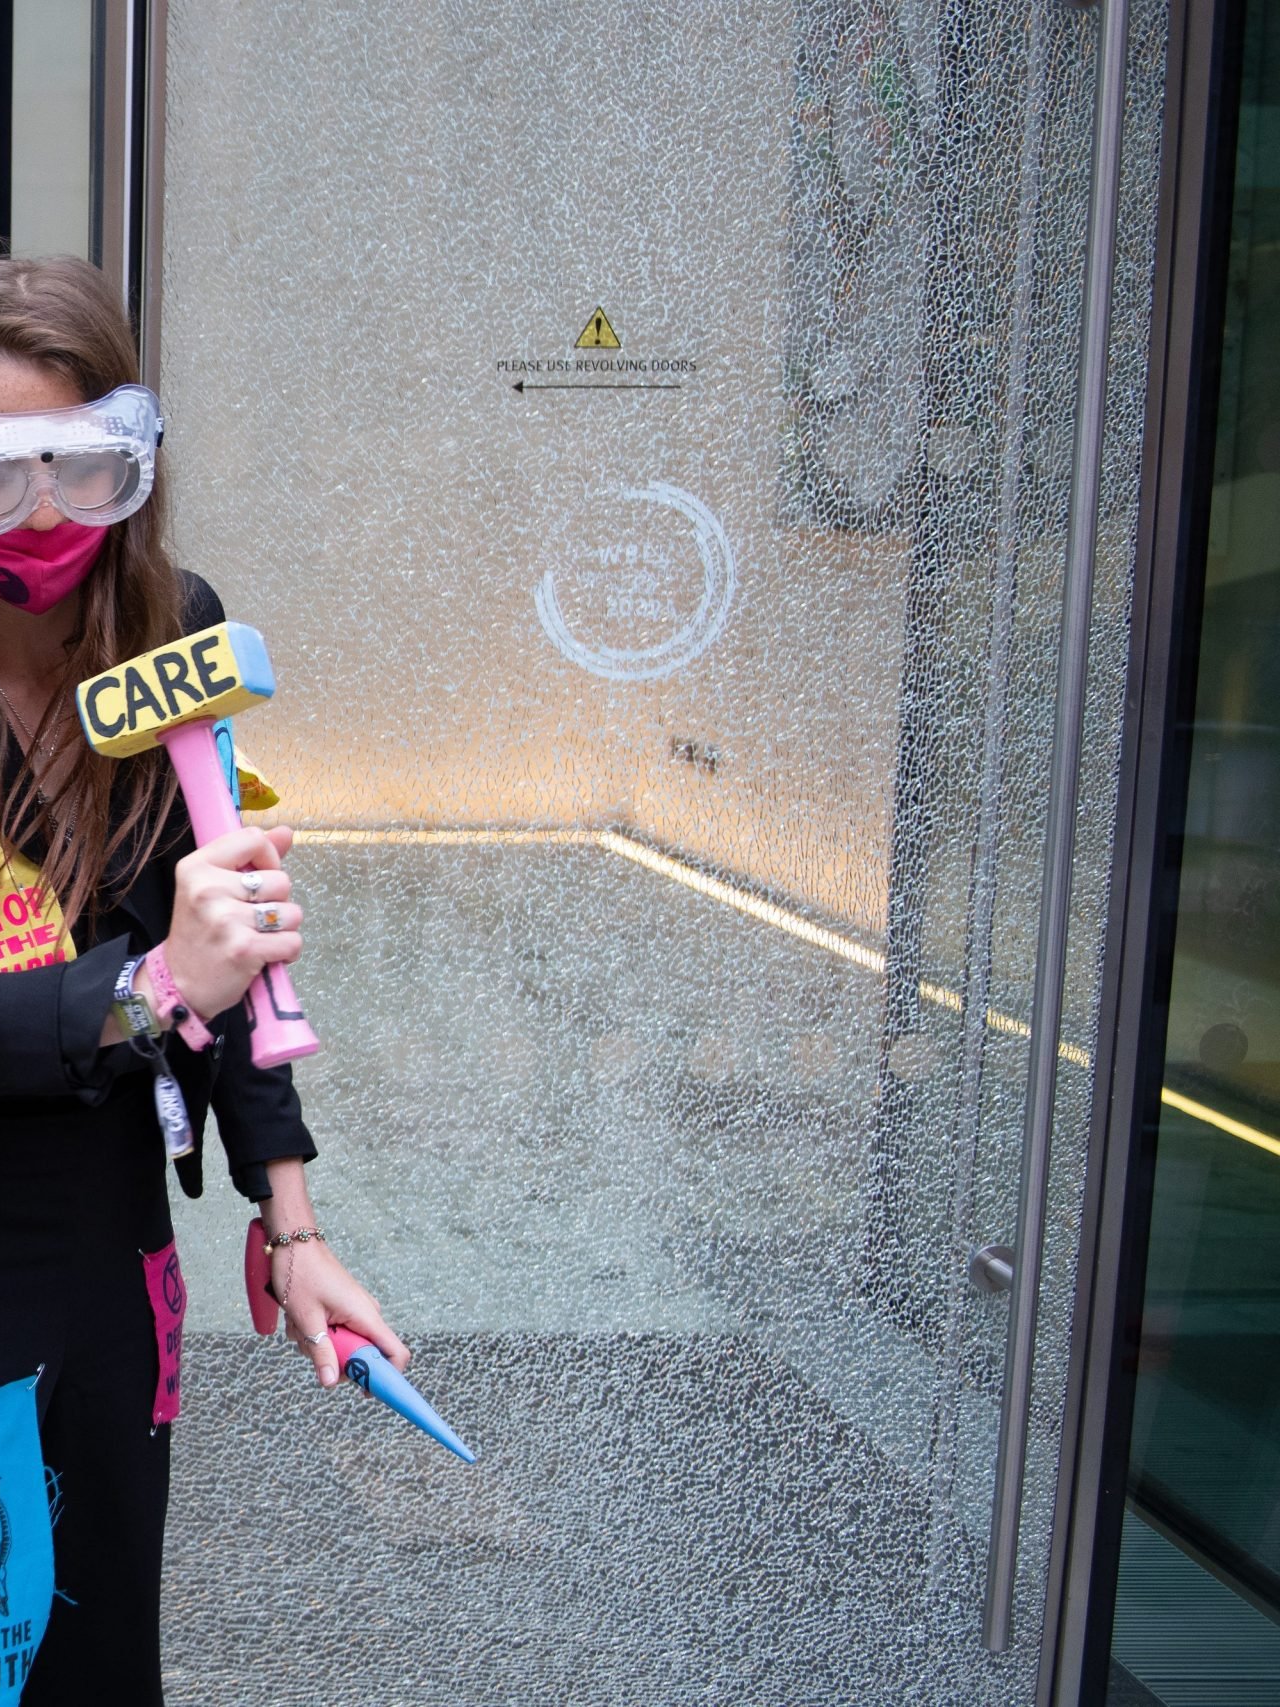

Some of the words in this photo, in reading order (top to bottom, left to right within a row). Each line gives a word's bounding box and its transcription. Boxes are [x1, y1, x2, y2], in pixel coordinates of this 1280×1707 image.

[496, 359, 542, 372] PLEASE
[546, 359, 570, 372] USE
[575, 359, 647, 372] REVOLVING
[651, 359, 697, 372] DOORS
[85, 635, 236, 738] CARE
[0, 1619, 32, 1649] THE
